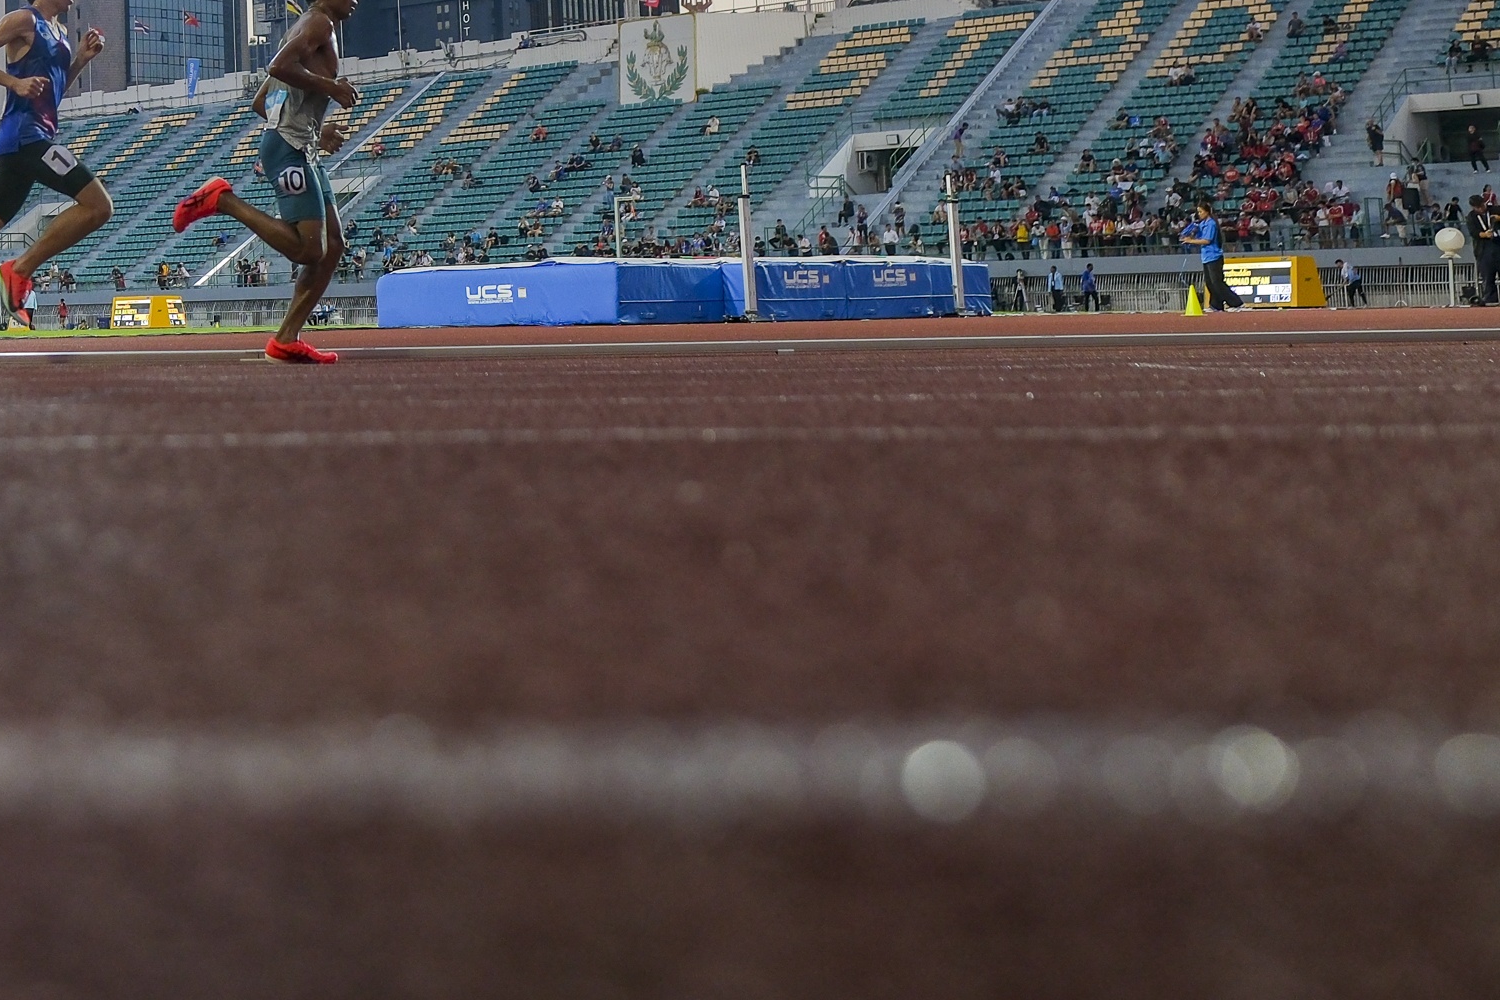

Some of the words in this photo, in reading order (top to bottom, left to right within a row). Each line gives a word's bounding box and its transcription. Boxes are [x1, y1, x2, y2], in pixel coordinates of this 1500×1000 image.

[462, 1, 470, 36] HOT
[52, 150, 71, 168] 1
[282, 170, 303, 191] 10
[784, 270, 819, 283] UCS
[872, 269, 907, 282] UCS
[466, 284, 512, 299] UCS
